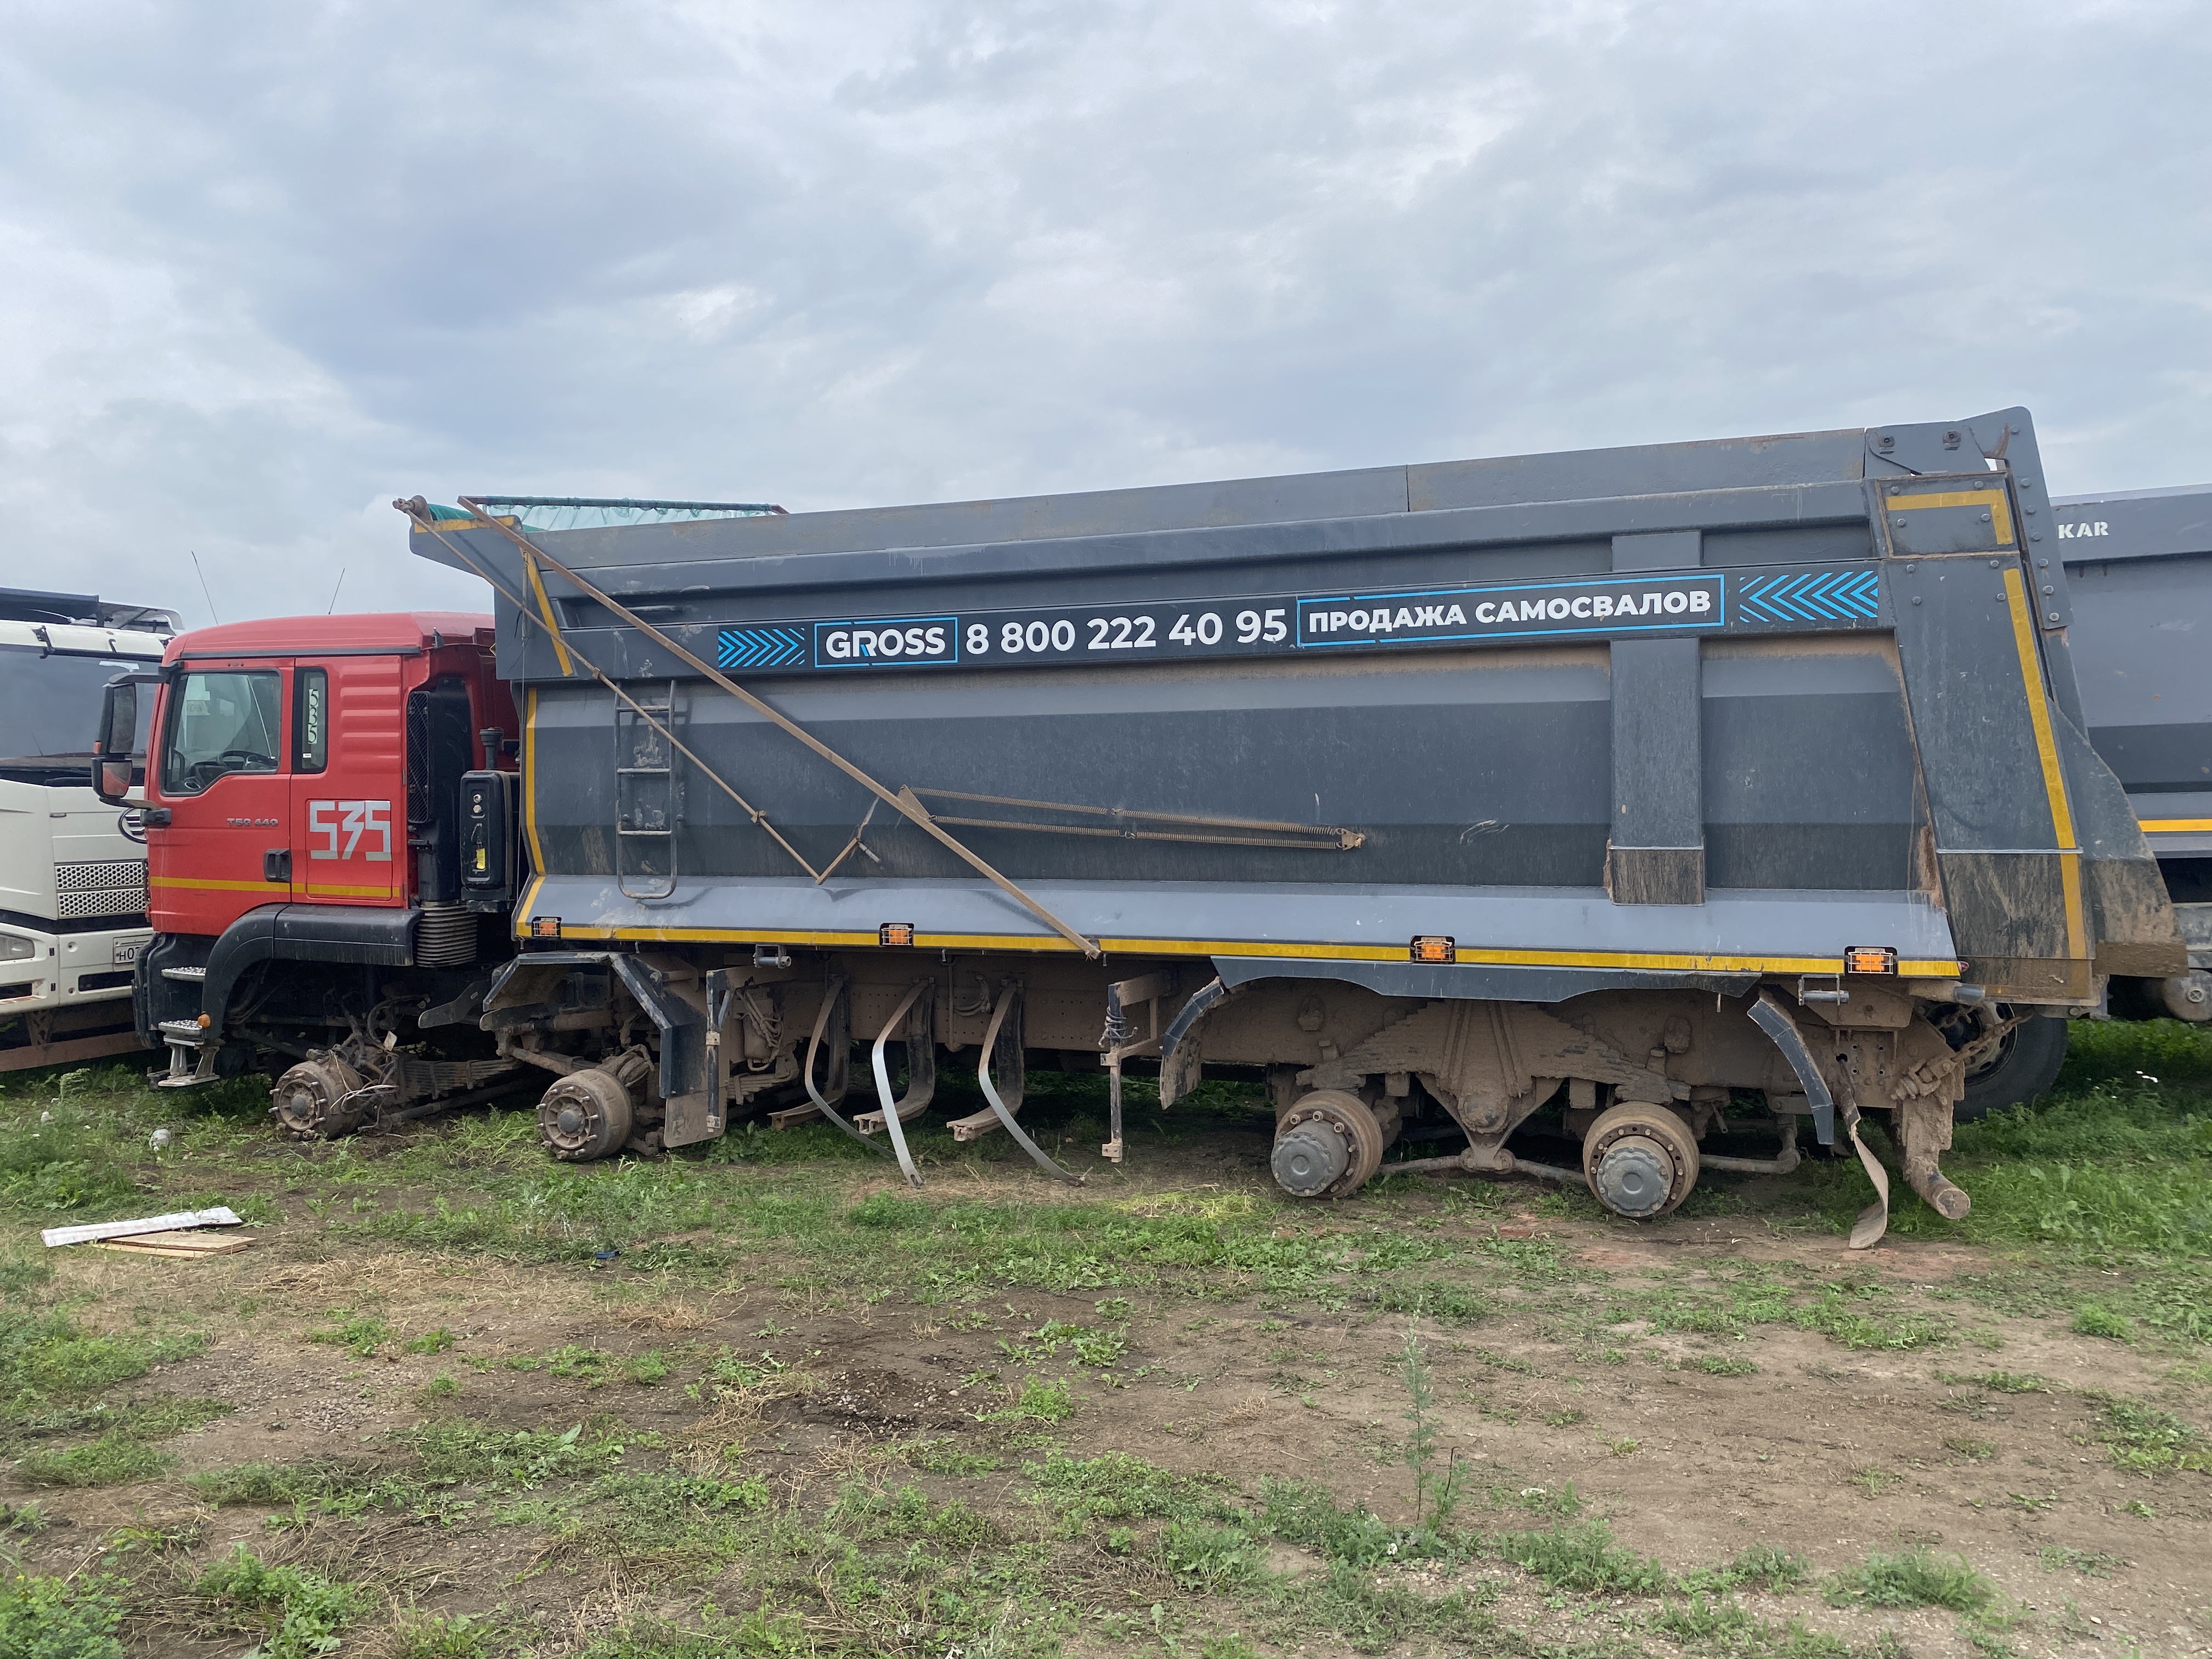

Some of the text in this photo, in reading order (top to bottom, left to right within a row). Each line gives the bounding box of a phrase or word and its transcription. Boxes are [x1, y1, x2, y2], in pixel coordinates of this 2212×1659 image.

[966, 608, 1287, 654] 8 800 222 40 95
[1309, 590, 1711, 634] ПРОДАЖА САМОСВАЛОВ
[826, 627, 945, 658] GROSS
[308, 689, 318, 743] 535
[254, 818, 279, 827] 440
[309, 800, 392, 861] 535
